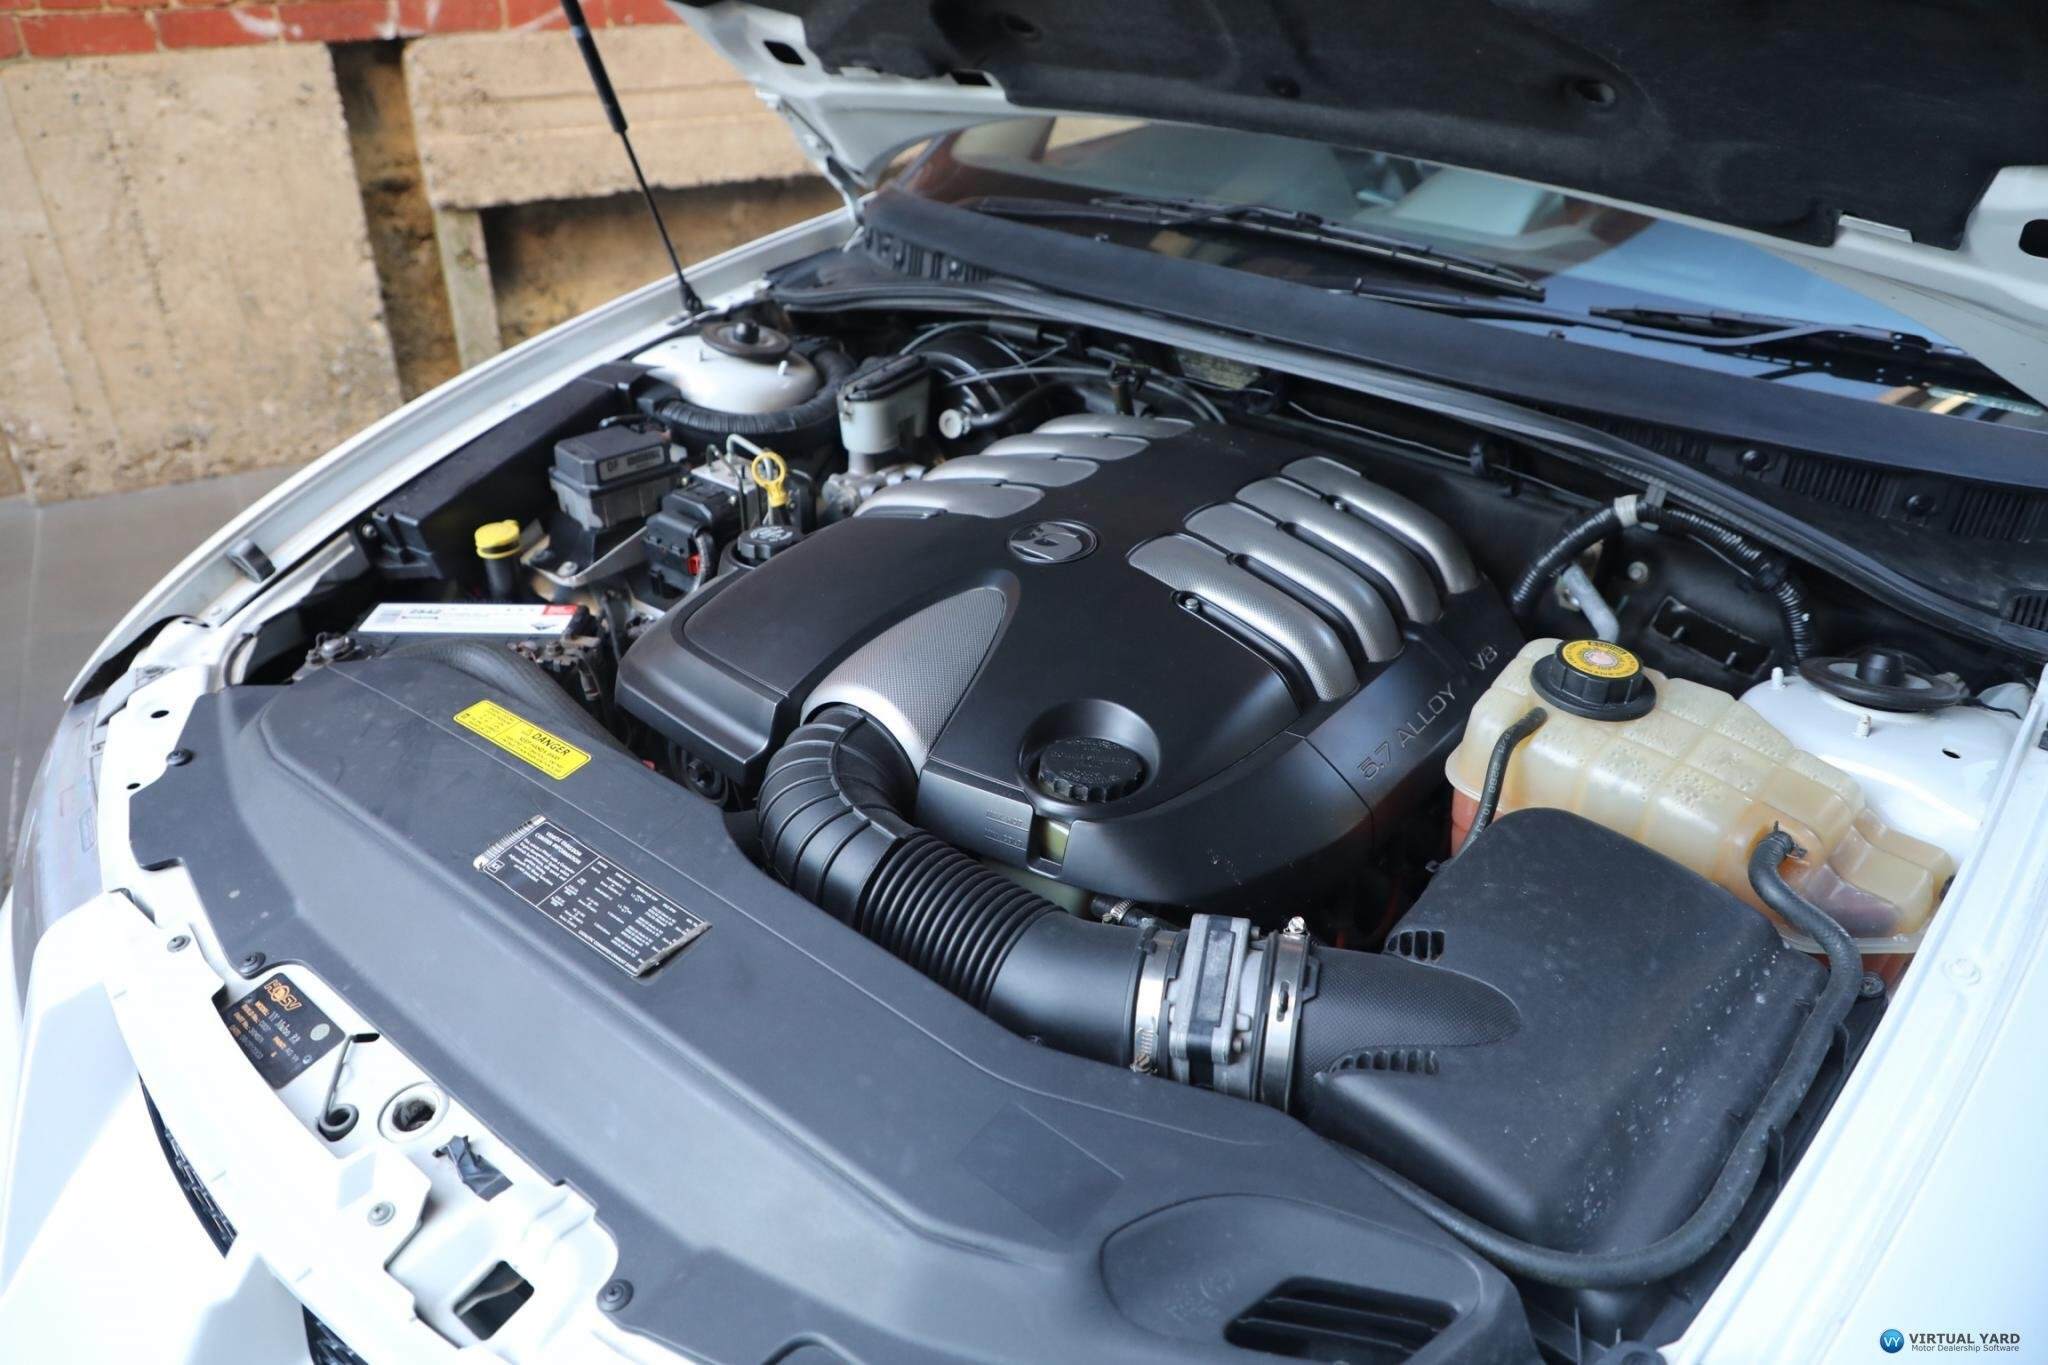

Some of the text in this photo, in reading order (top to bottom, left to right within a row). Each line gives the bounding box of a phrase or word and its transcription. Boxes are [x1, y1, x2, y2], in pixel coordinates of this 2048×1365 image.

[531, 732, 571, 756] DANGER
[1357, 645, 1498, 780] 5.7 ALLOY V8
